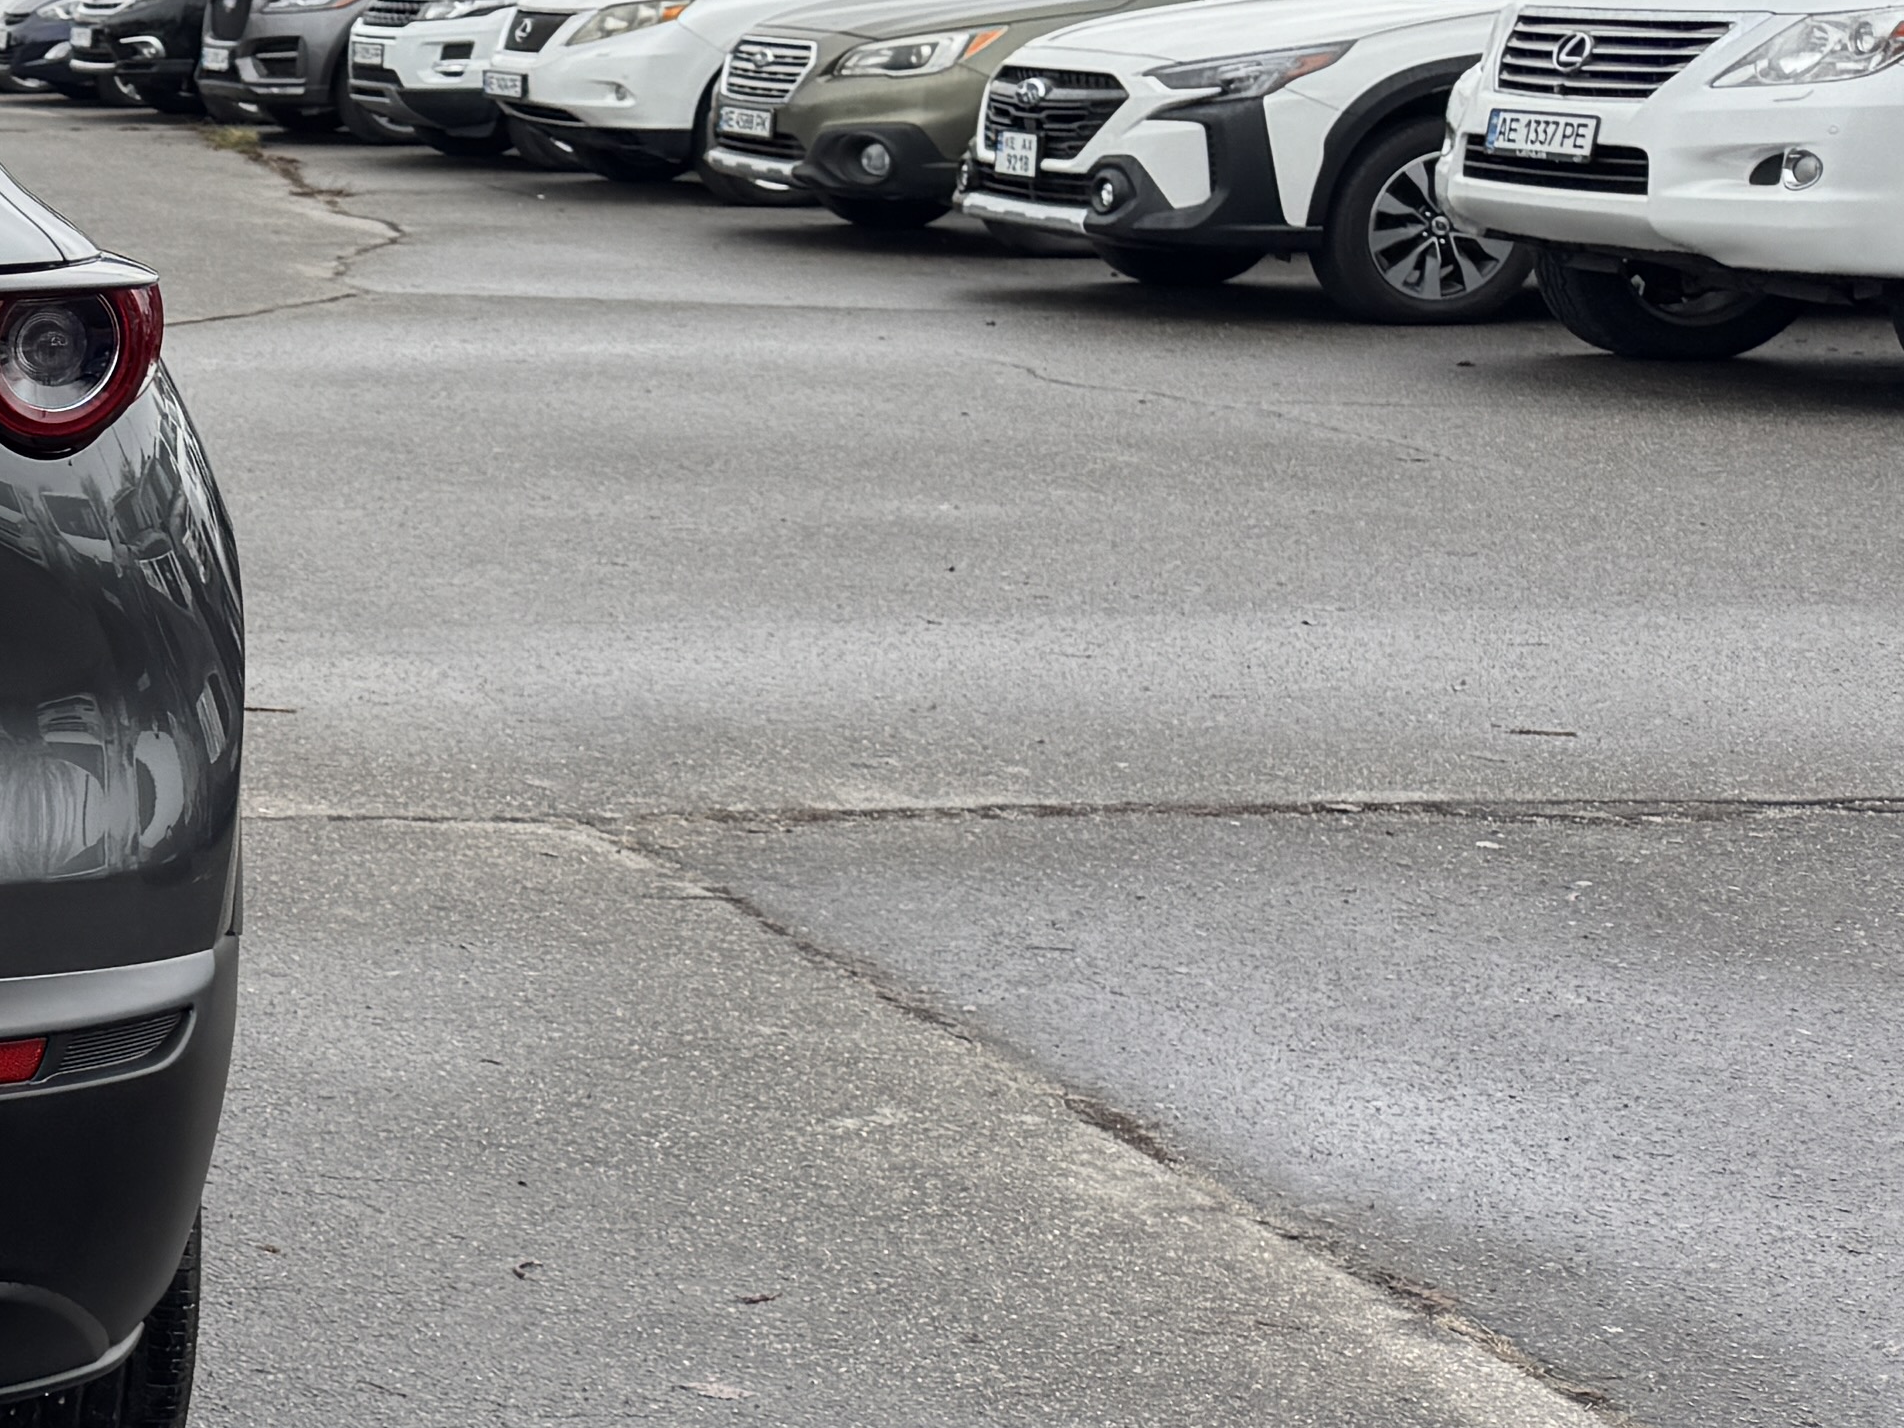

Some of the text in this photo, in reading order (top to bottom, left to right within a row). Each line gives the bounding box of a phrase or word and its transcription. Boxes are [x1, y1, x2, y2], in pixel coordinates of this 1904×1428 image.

[1496, 117, 1589, 149] AE 1337 PE
